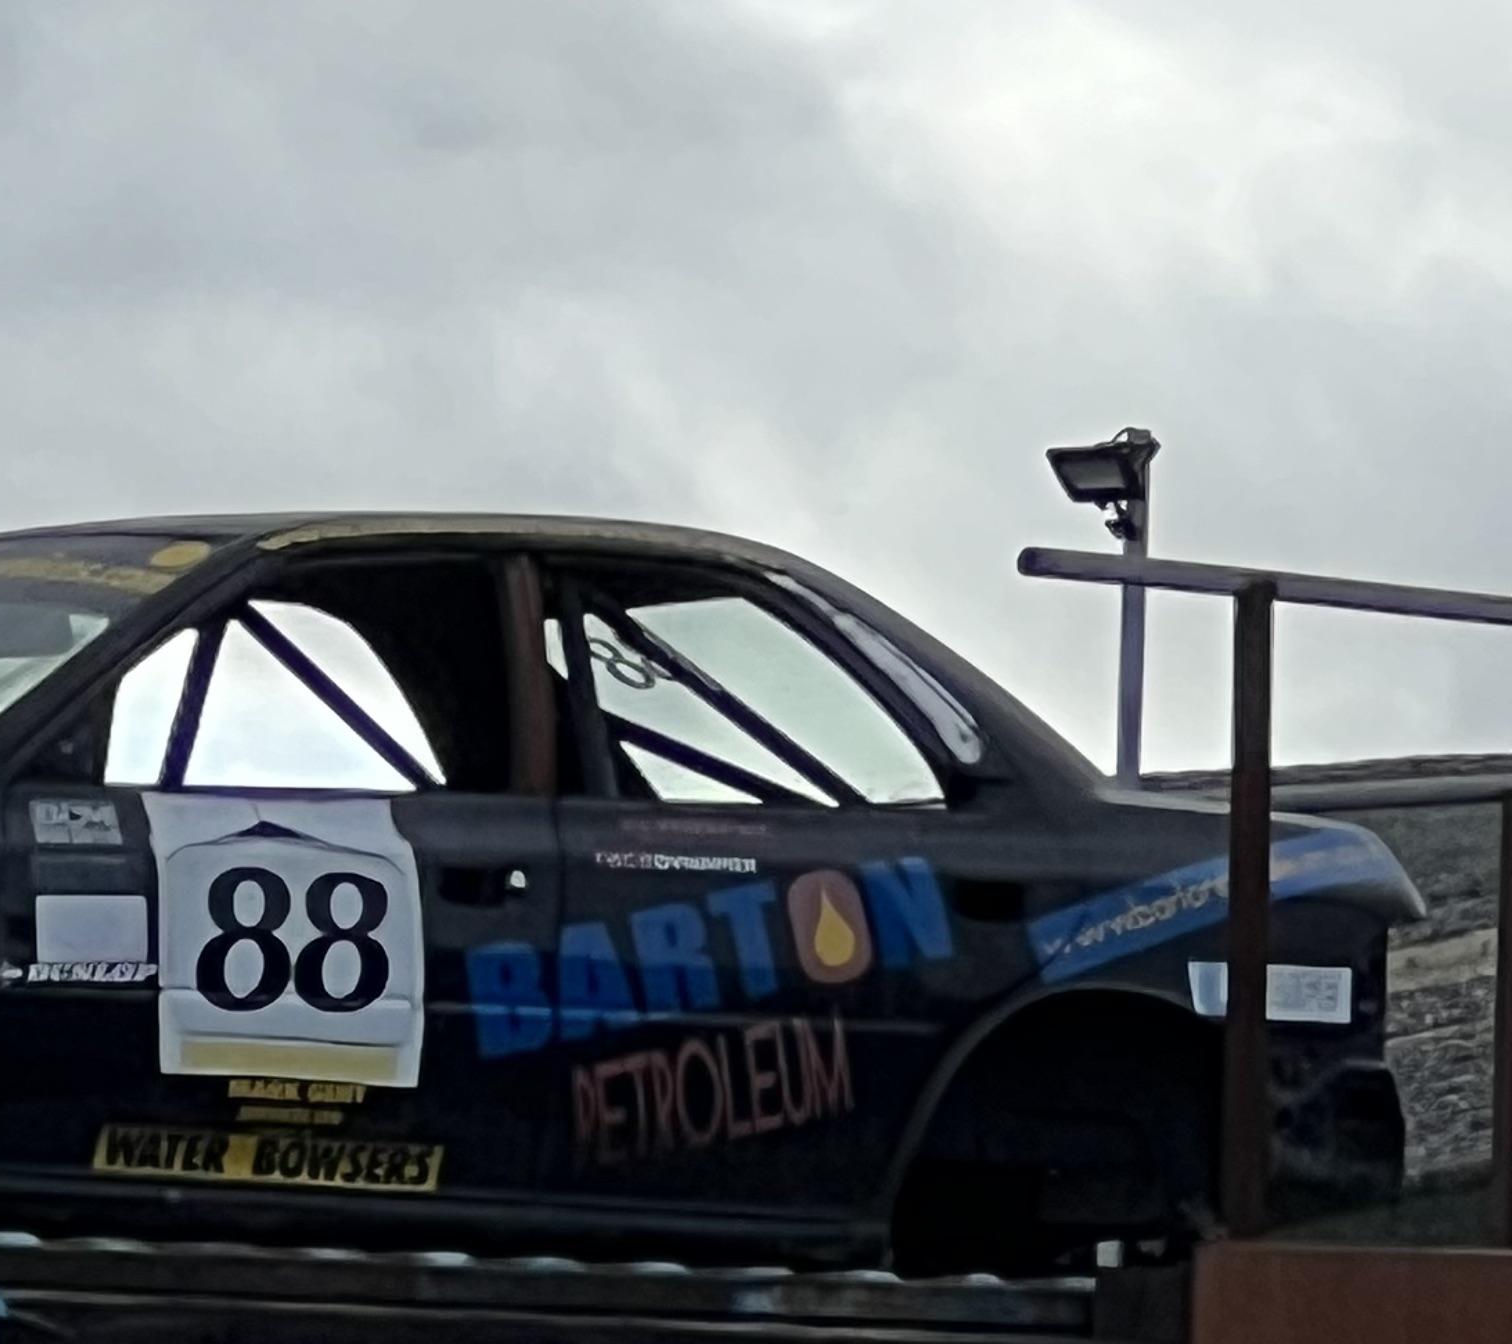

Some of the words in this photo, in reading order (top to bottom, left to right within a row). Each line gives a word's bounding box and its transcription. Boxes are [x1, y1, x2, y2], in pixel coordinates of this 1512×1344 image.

[26, 962, 159, 983] DUNLOP
[197, 865, 390, 1013] 88
[464, 856, 954, 1058] BARTON
[106, 1128, 228, 1173] WATER
[253, 1136, 433, 1186] BOWSERS
[570, 1008, 856, 1168] PETROLEUM
